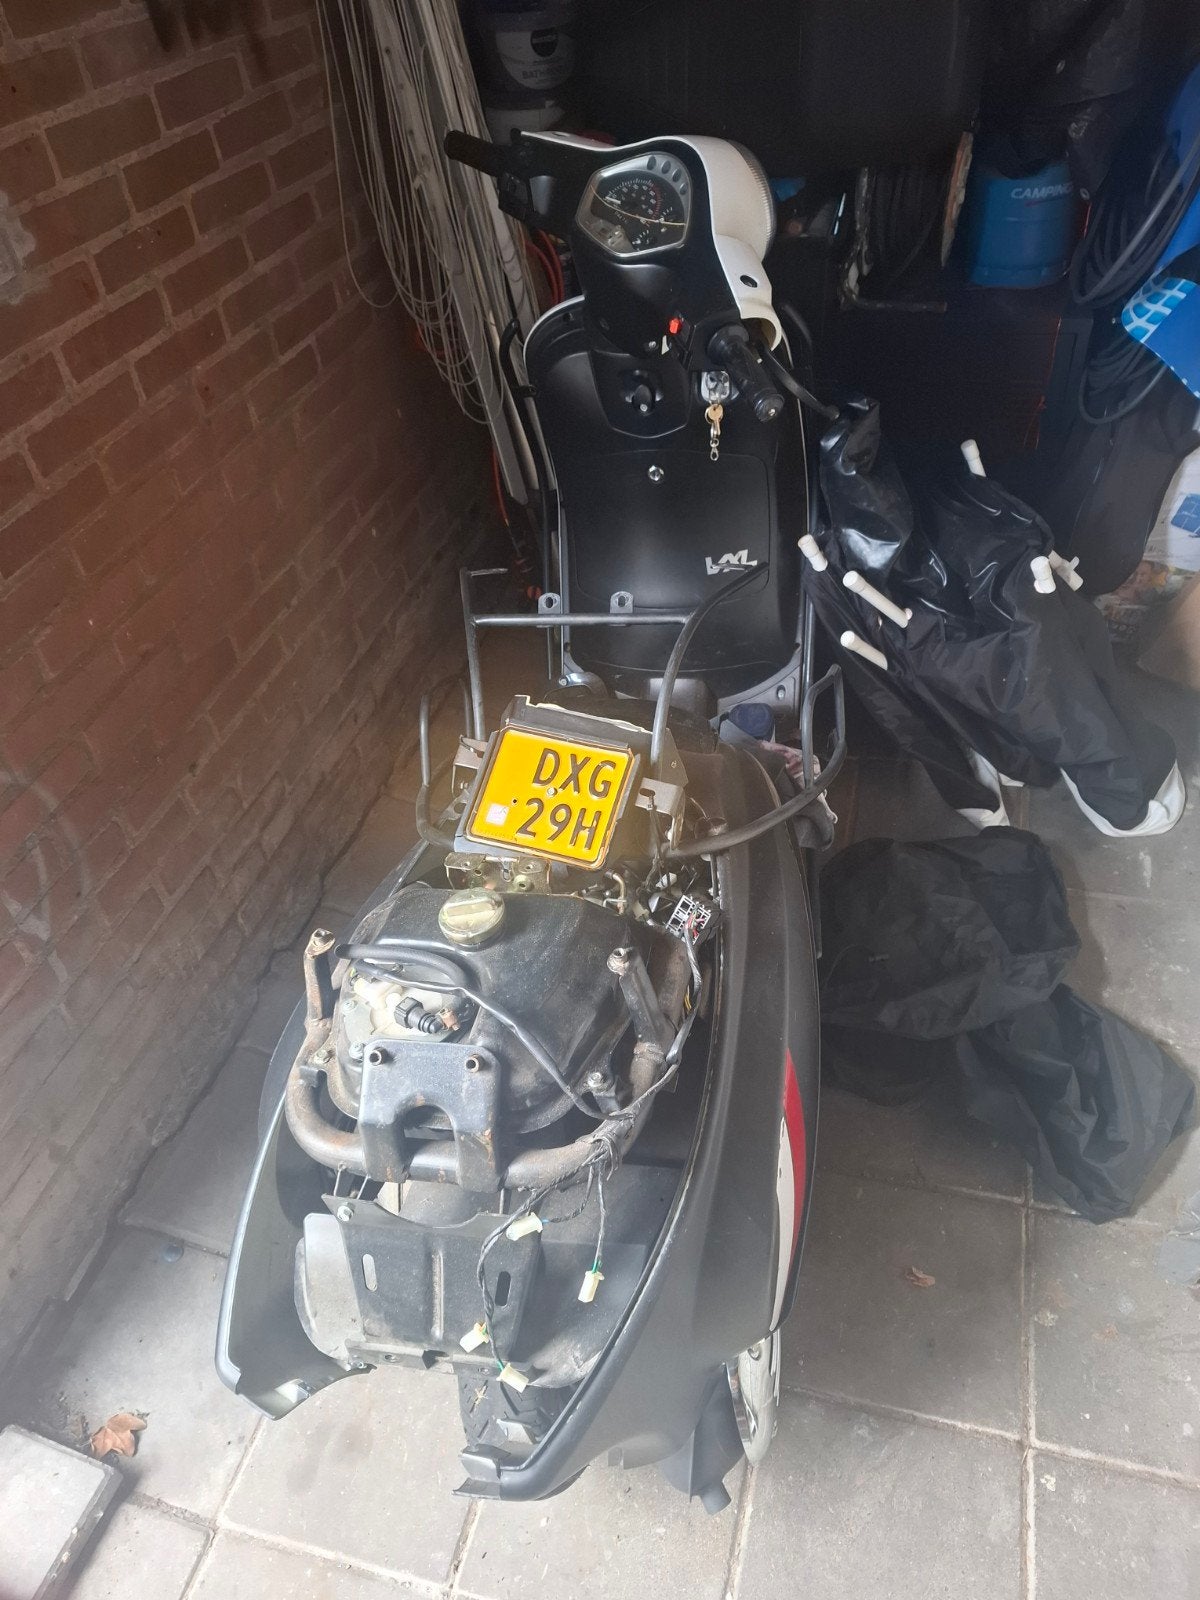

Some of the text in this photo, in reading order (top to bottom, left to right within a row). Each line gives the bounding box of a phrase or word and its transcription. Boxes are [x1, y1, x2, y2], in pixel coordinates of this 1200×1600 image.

[1010, 181, 1074, 200] CAMPING
[532, 747, 617, 799] DXG
[516, 797, 602, 851] 29H
